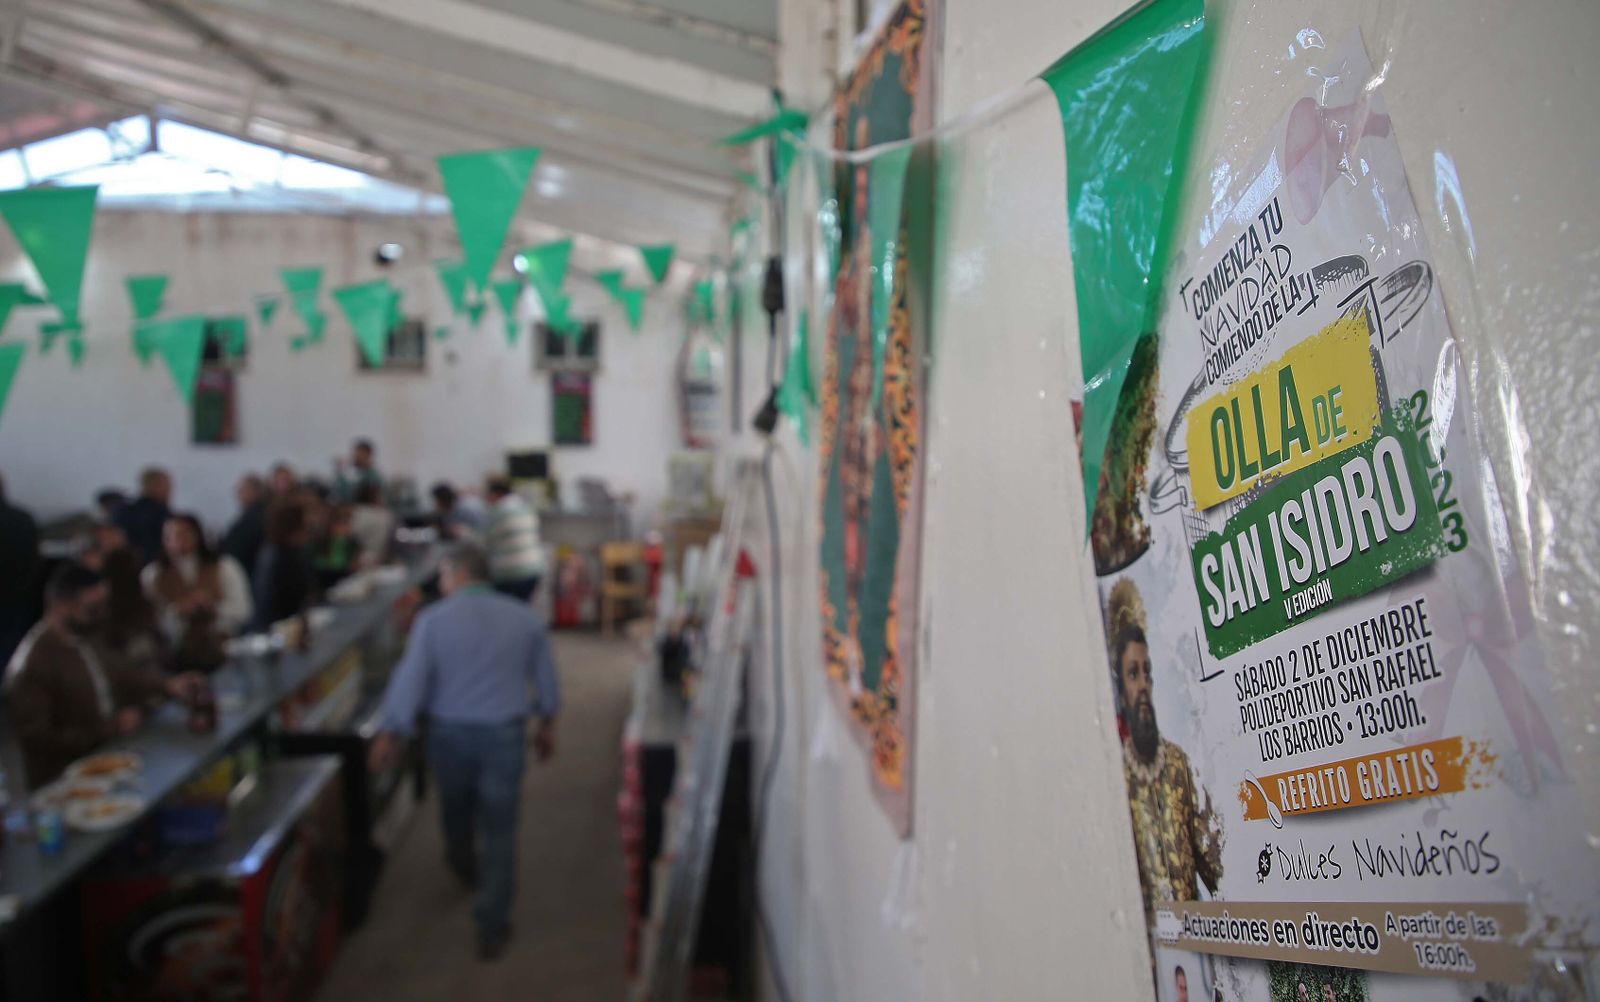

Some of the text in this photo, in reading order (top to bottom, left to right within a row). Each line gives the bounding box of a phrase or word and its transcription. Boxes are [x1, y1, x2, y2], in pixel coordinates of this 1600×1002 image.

[1193, 197, 1283, 320] COMIENZA TU
[1200, 244, 1292, 350] NAVIDAD
[1205, 319, 1264, 385] COMIENDO
[1264, 301, 1283, 332] DE
[1210, 364, 1348, 491] OLLA DE
[1201, 436, 1417, 628] SAN ISIDRO
[1283, 578, 1333, 620] V EDICIÓN
[1234, 598, 1432, 702] SÁBADO 2 DE DICIEMBRE
[1240, 642, 1441, 733] POLIDEPORTIVO SAN RAFAEL
[1258, 690, 1427, 762] LOS BARRIOS 13:00h.
[1277, 749, 1440, 812] REFRITO GRATIS
[1276, 829, 1500, 881] Dulces Navideños
[1182, 912, 1496, 954] Actuaciones en directo A partir de las
[1414, 943, 1475, 970] 16:00h.
